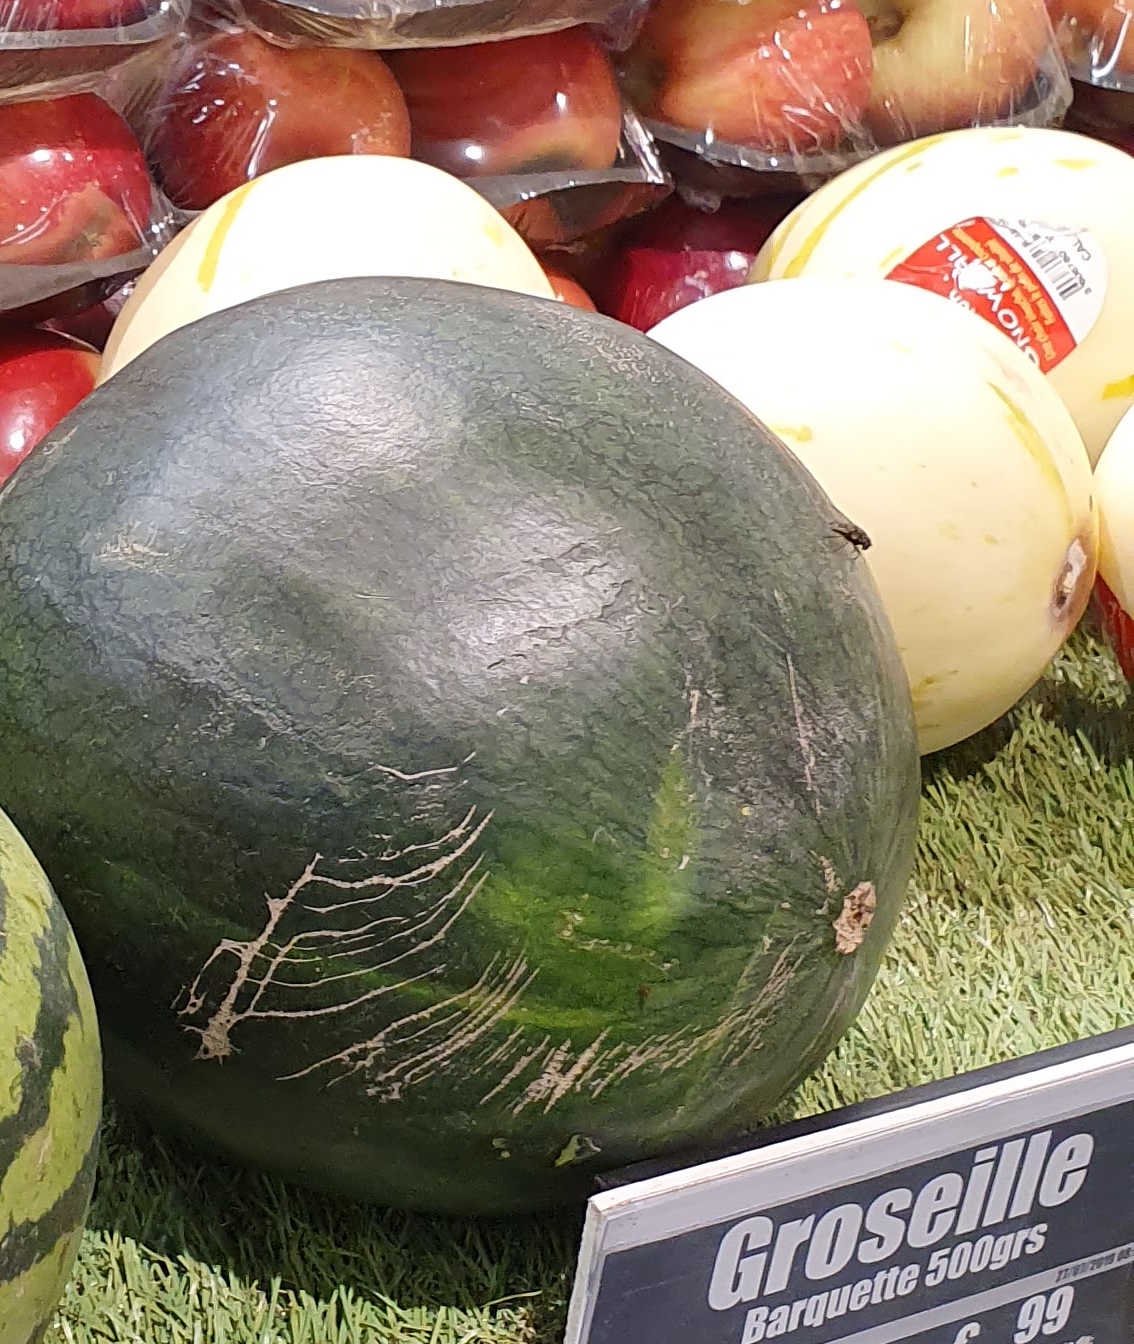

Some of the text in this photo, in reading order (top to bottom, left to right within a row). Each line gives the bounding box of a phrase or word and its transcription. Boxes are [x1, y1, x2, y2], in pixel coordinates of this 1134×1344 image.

[708, 1129, 1095, 1311] Groseille
[925, 1222, 1048, 1287] 500grs
[1013, 1285, 1075, 1344] 99
